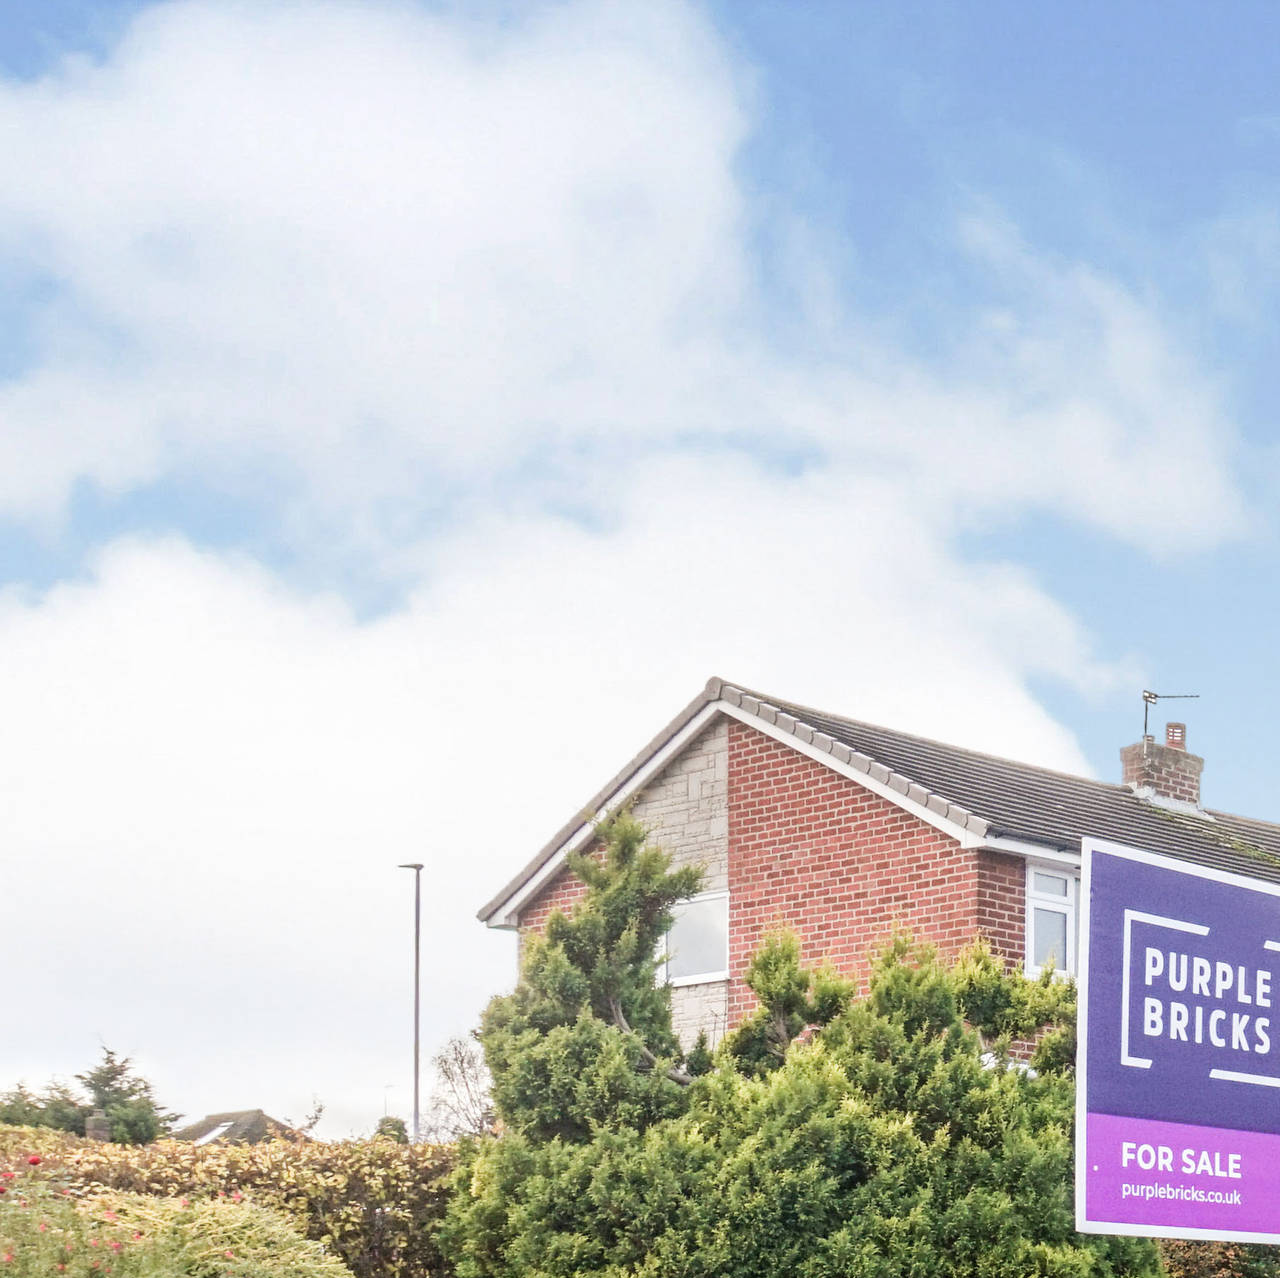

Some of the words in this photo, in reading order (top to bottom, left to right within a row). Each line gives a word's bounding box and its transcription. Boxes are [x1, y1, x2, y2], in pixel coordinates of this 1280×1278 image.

[1145, 947, 1272, 1007] PURPLE
[1143, 997, 1271, 1055] BRICKS
[1121, 1141, 1173, 1172] FOR
[1181, 1148, 1242, 1179] SALE
[1121, 1182, 1242, 1205] purplebricks.co.uk
